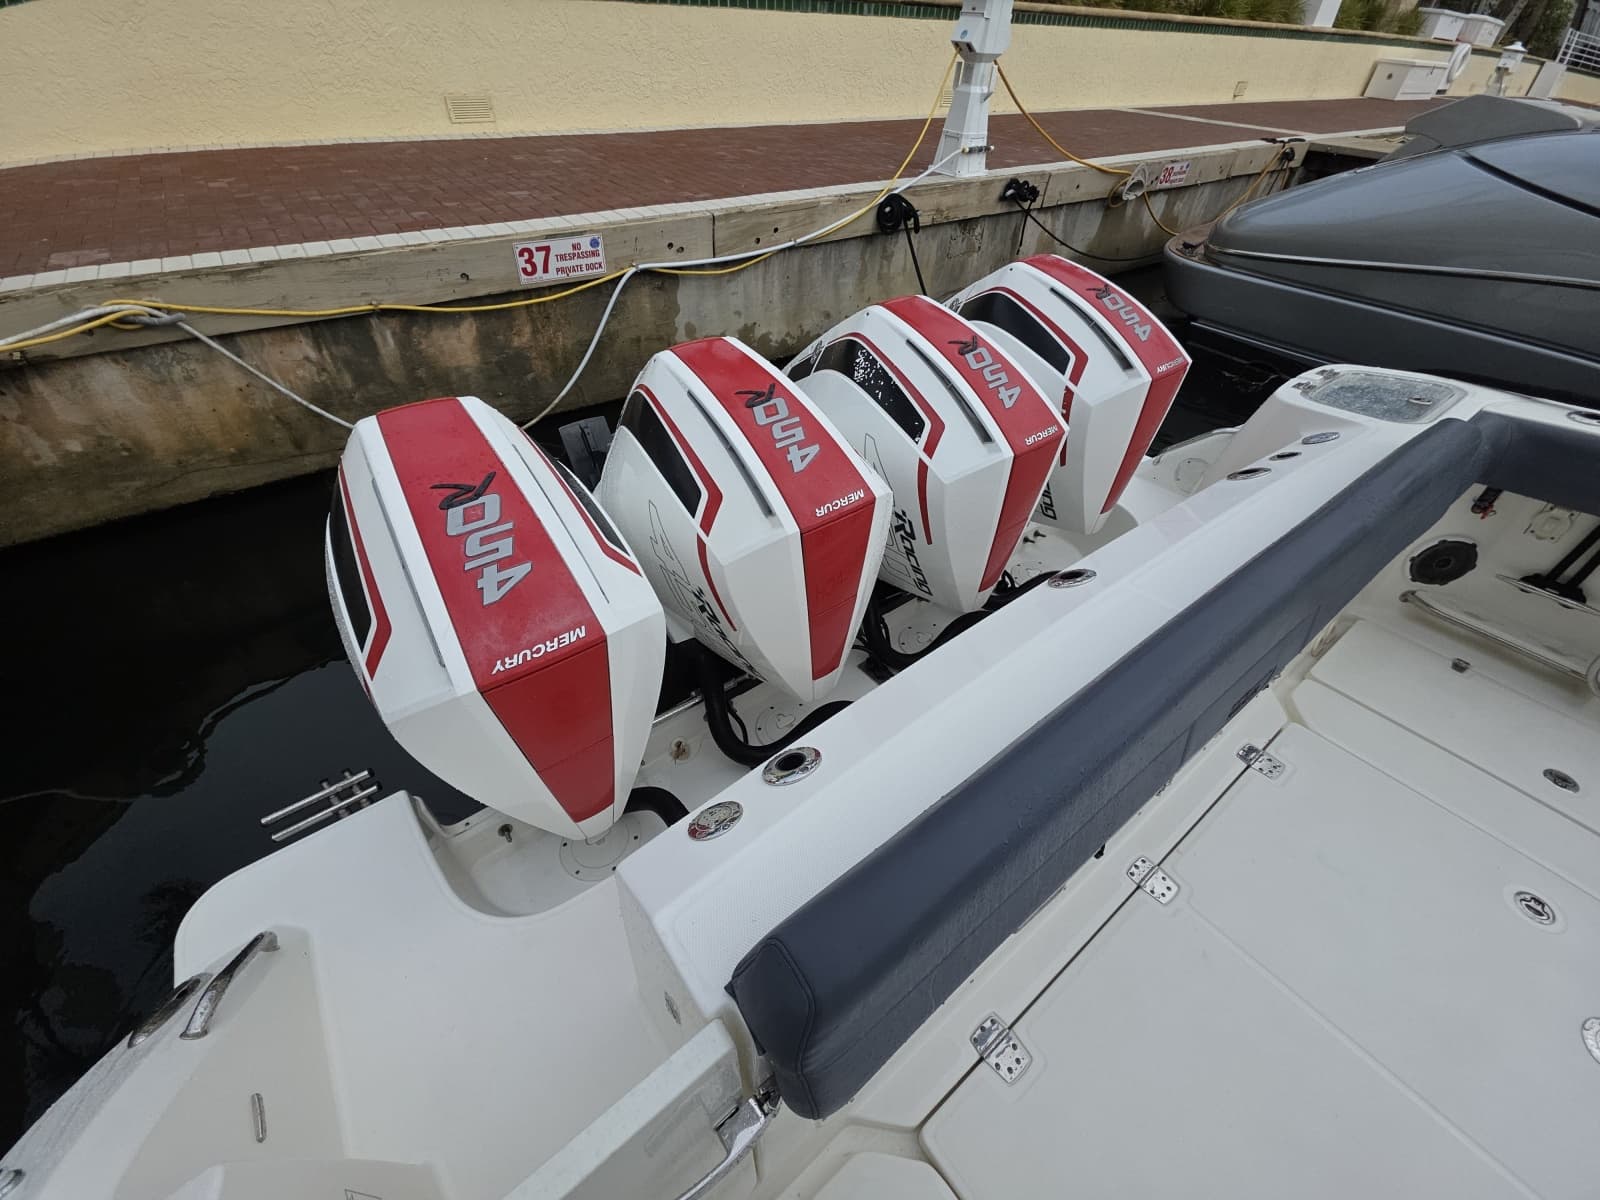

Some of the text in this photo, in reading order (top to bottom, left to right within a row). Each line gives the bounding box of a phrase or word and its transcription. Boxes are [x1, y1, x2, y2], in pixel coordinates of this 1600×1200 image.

[518, 245, 551, 277] 37
[555, 249, 600, 262] TRESPASSING
[572, 242, 581, 251] NO
[556, 262, 603, 275] PRIVATE DOCK
[735, 383, 820, 473] 450R
[1024, 424, 1058, 446] MERCUR
[815, 488, 864, 518] MERCUR
[430, 471, 533, 607] 450R
[894, 509, 933, 597] Racing
[491, 625, 586, 675] MERCURY
